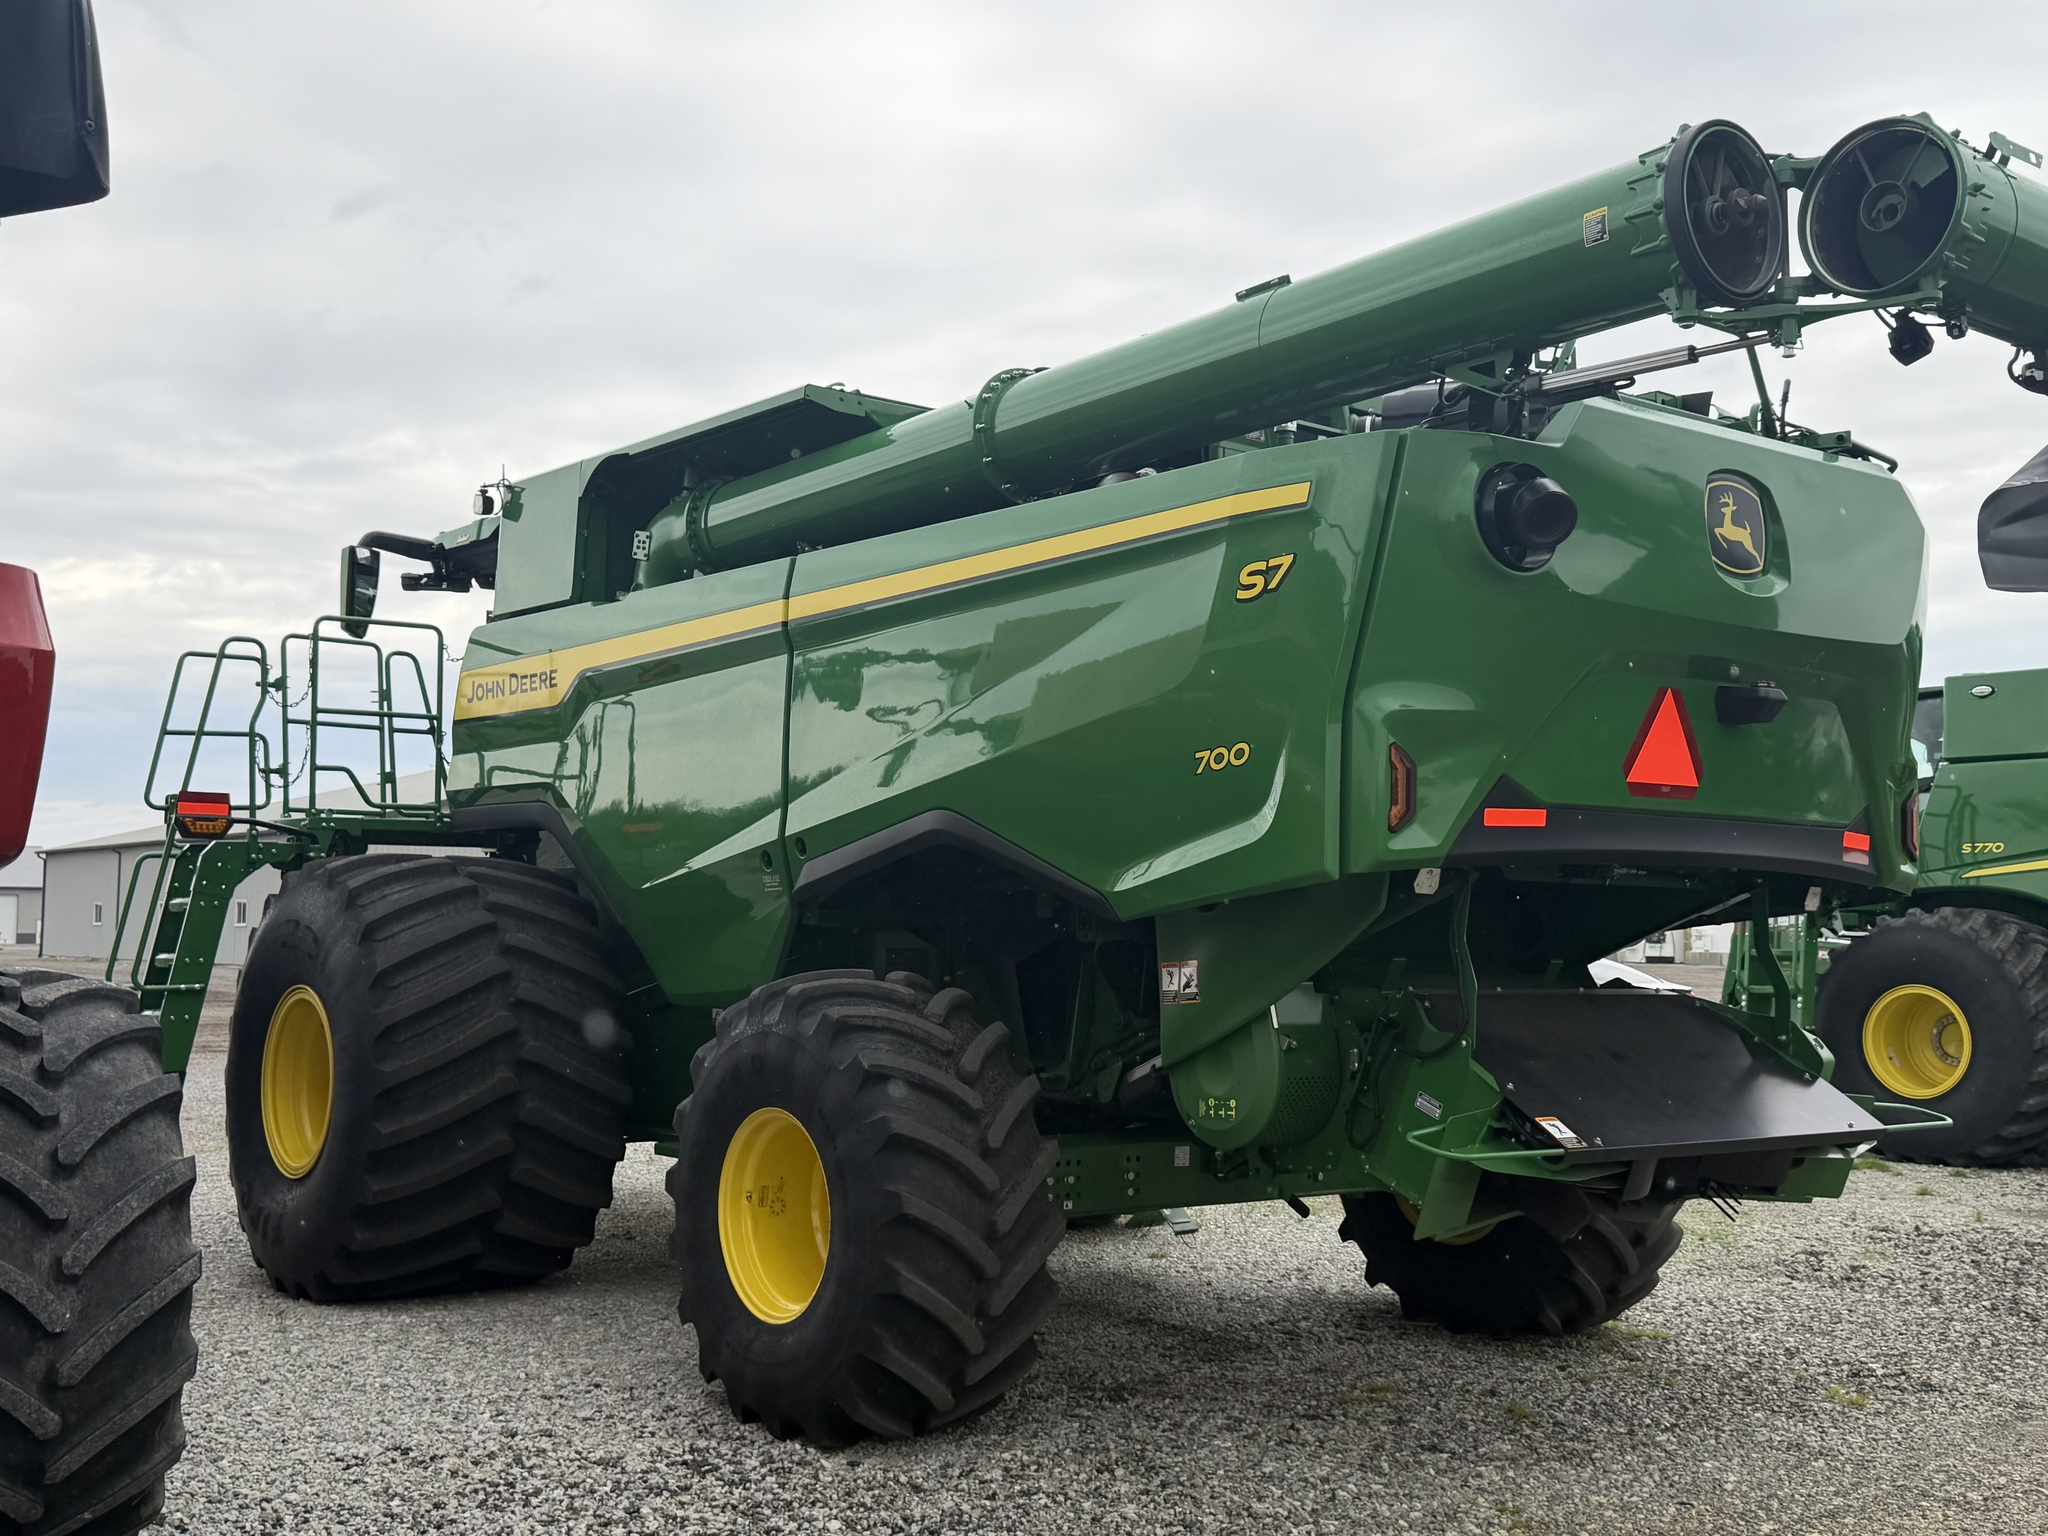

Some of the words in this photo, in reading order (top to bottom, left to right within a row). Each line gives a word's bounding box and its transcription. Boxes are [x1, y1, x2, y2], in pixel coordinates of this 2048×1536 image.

[1235, 553, 1296, 602] S7
[467, 679, 505, 704] JOHN
[508, 669, 558, 696] DEERE
[1194, 742, 1251, 775] 700
